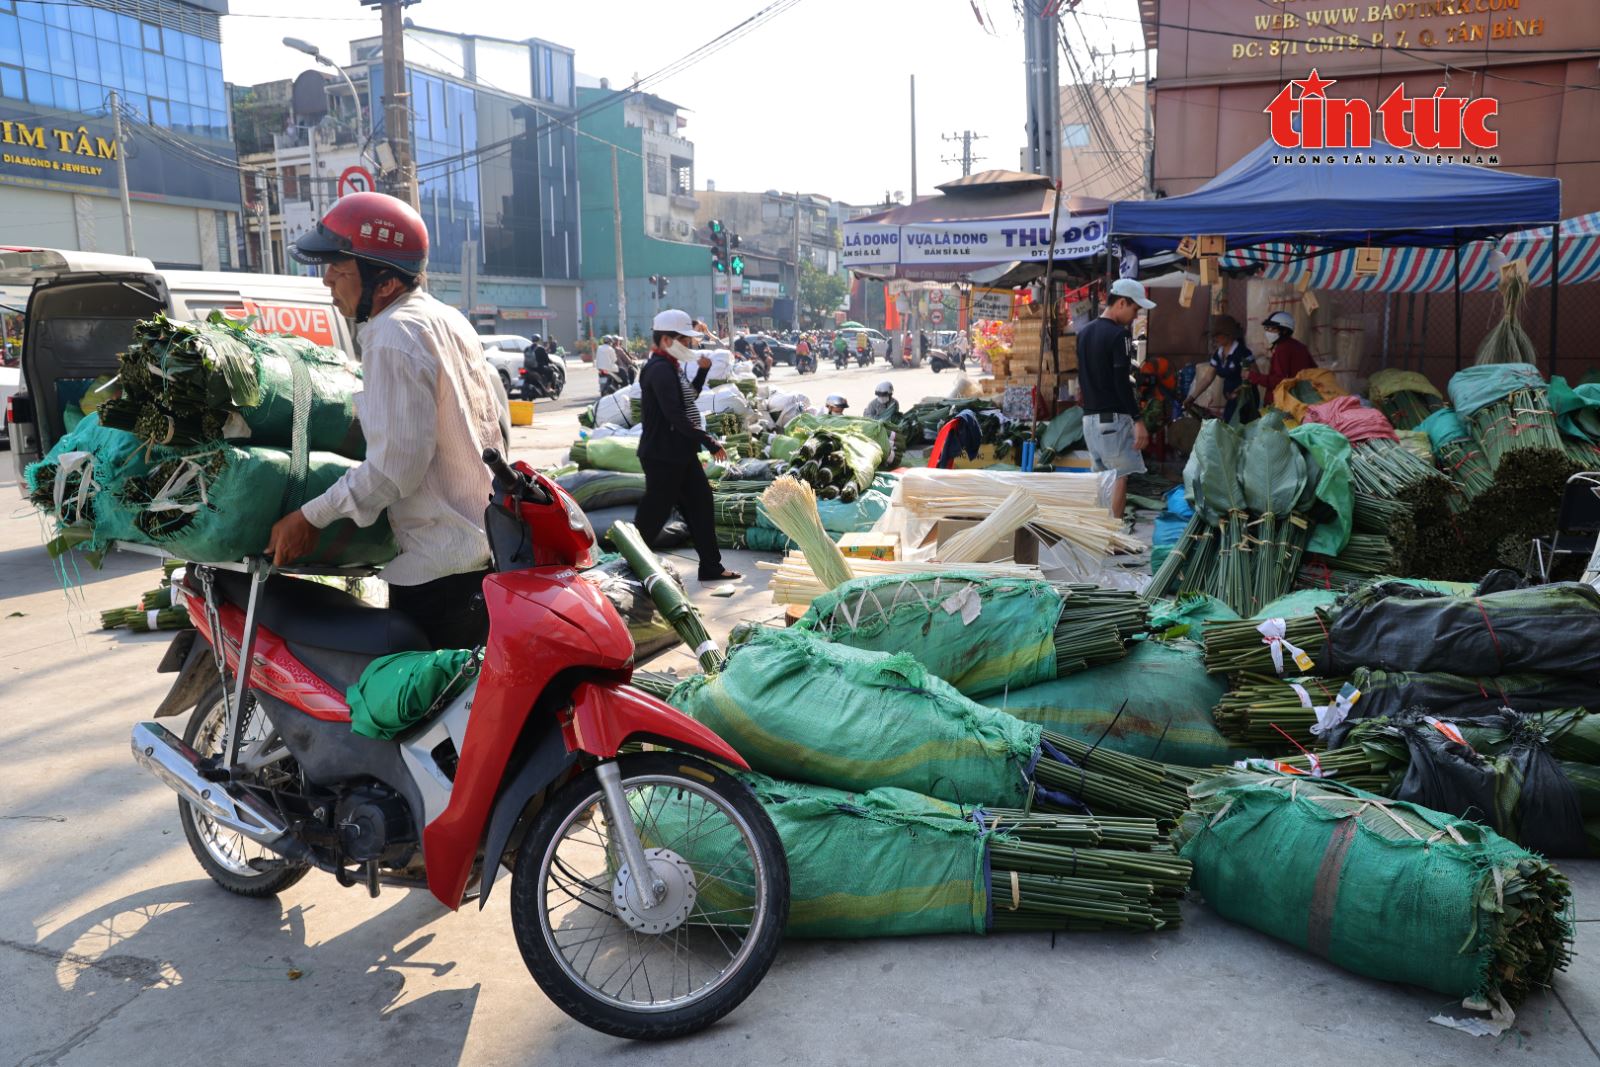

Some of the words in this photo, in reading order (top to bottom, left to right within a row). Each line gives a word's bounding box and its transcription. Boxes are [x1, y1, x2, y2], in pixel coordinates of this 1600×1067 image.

[1254, 13, 1301, 31] WEB:
[1232, 42, 1264, 60] ĐC:
[1269, 40, 1299, 56] 871
[53, 125, 118, 160] TÂM
[3, 153, 52, 168] DIAMOND
[52, 160, 60, 170] &
[61, 162, 102, 175] JEWELRY
[864, 233, 898, 246] DONG
[907, 233, 932, 249] VỰA
[953, 233, 988, 245] DONG
